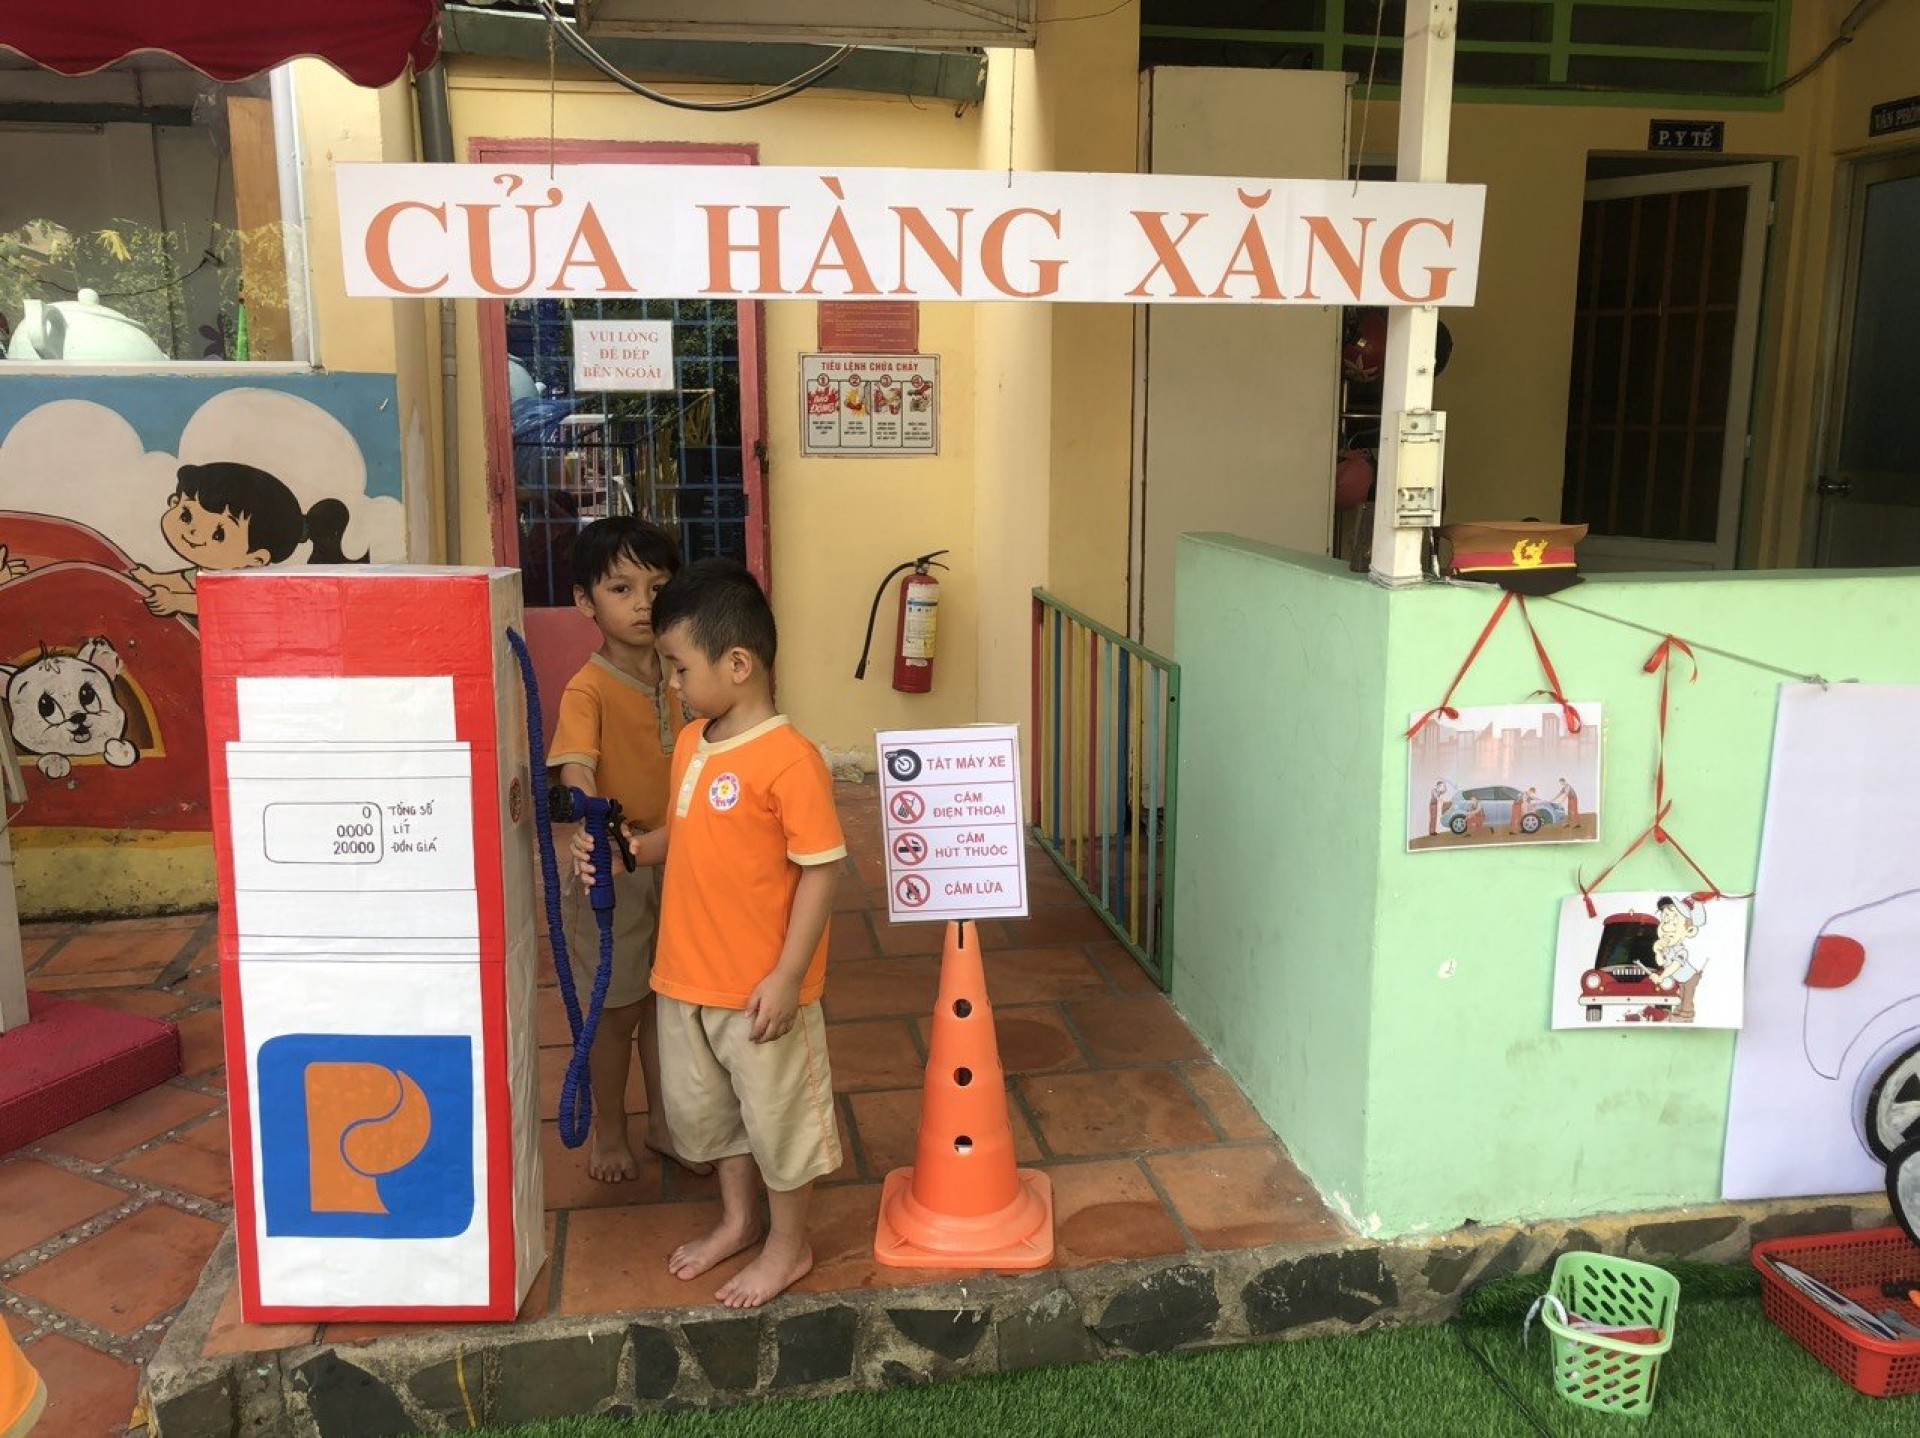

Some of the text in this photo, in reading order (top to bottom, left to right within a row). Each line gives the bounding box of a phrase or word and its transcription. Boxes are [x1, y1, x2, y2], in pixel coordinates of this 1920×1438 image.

[1657, 125, 1715, 147] P. Y TẾ
[364, 174, 1457, 303] CỬA HÀNG XĂNG
[589, 328, 659, 343] VUI LÒNG
[622, 345, 650, 360] DÉP
[583, 363, 662, 379] BÊN NGOÀI
[844, 361, 867, 373] LỆNH
[869, 361, 893, 371] CHỮA
[896, 361, 919, 372] CHÁY
[926, 754, 1006, 770] TẮT MÁY XE
[954, 790, 983, 803] CẤM
[362, 806, 372, 819] 0
[419, 798, 436, 816] SỐ
[933, 805, 1006, 819] ĐIỆN THOẠI
[336, 823, 374, 838] 0000
[956, 831, 985, 844] CẤM
[333, 840, 376, 855] 20000
[416, 835, 438, 852] GIÁ
[935, 844, 1008, 858] HÚT THUỐC
[944, 879, 1003, 896] CẤM LỬA
